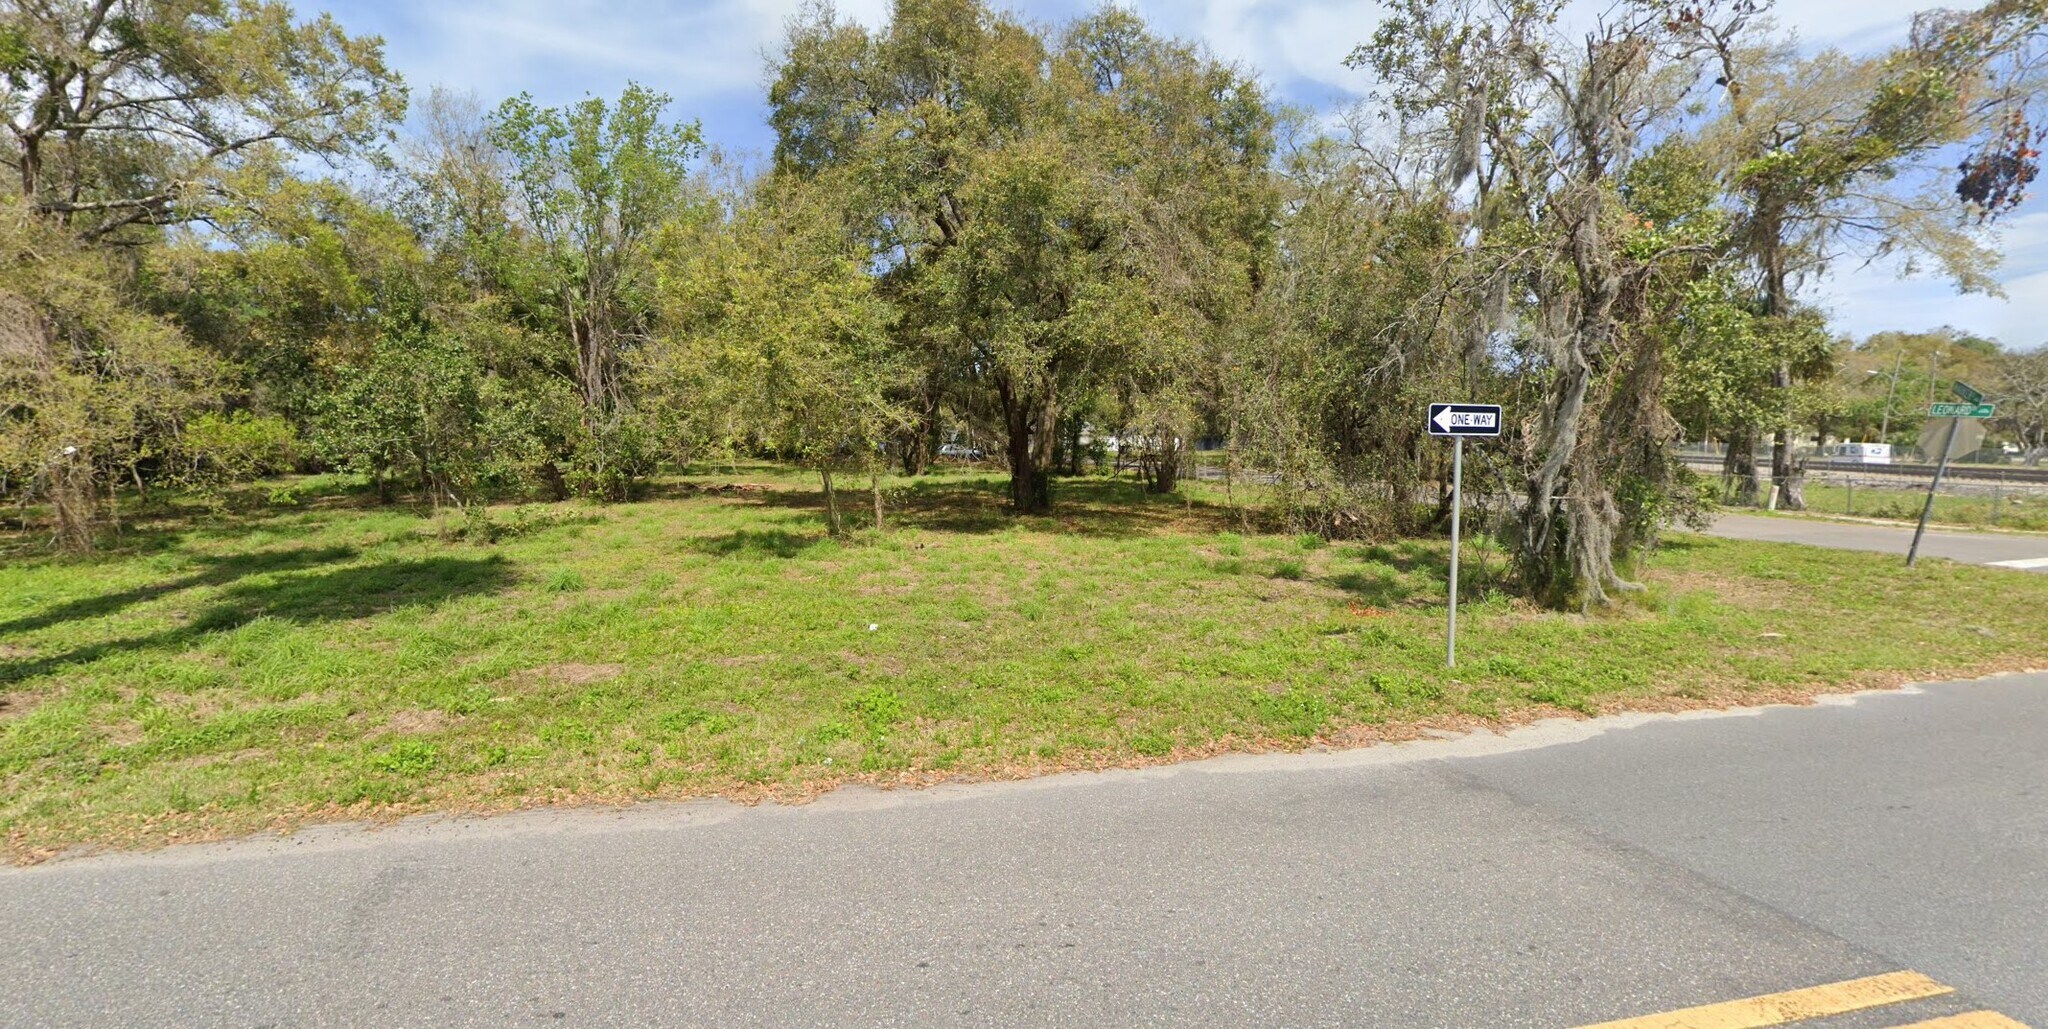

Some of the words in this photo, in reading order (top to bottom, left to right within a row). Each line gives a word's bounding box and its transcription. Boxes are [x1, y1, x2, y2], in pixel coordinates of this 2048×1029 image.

[1932, 405, 1972, 415] LEONARD
[1451, 414, 1470, 425] ONE
[1473, 414, 1493, 426] WAY
